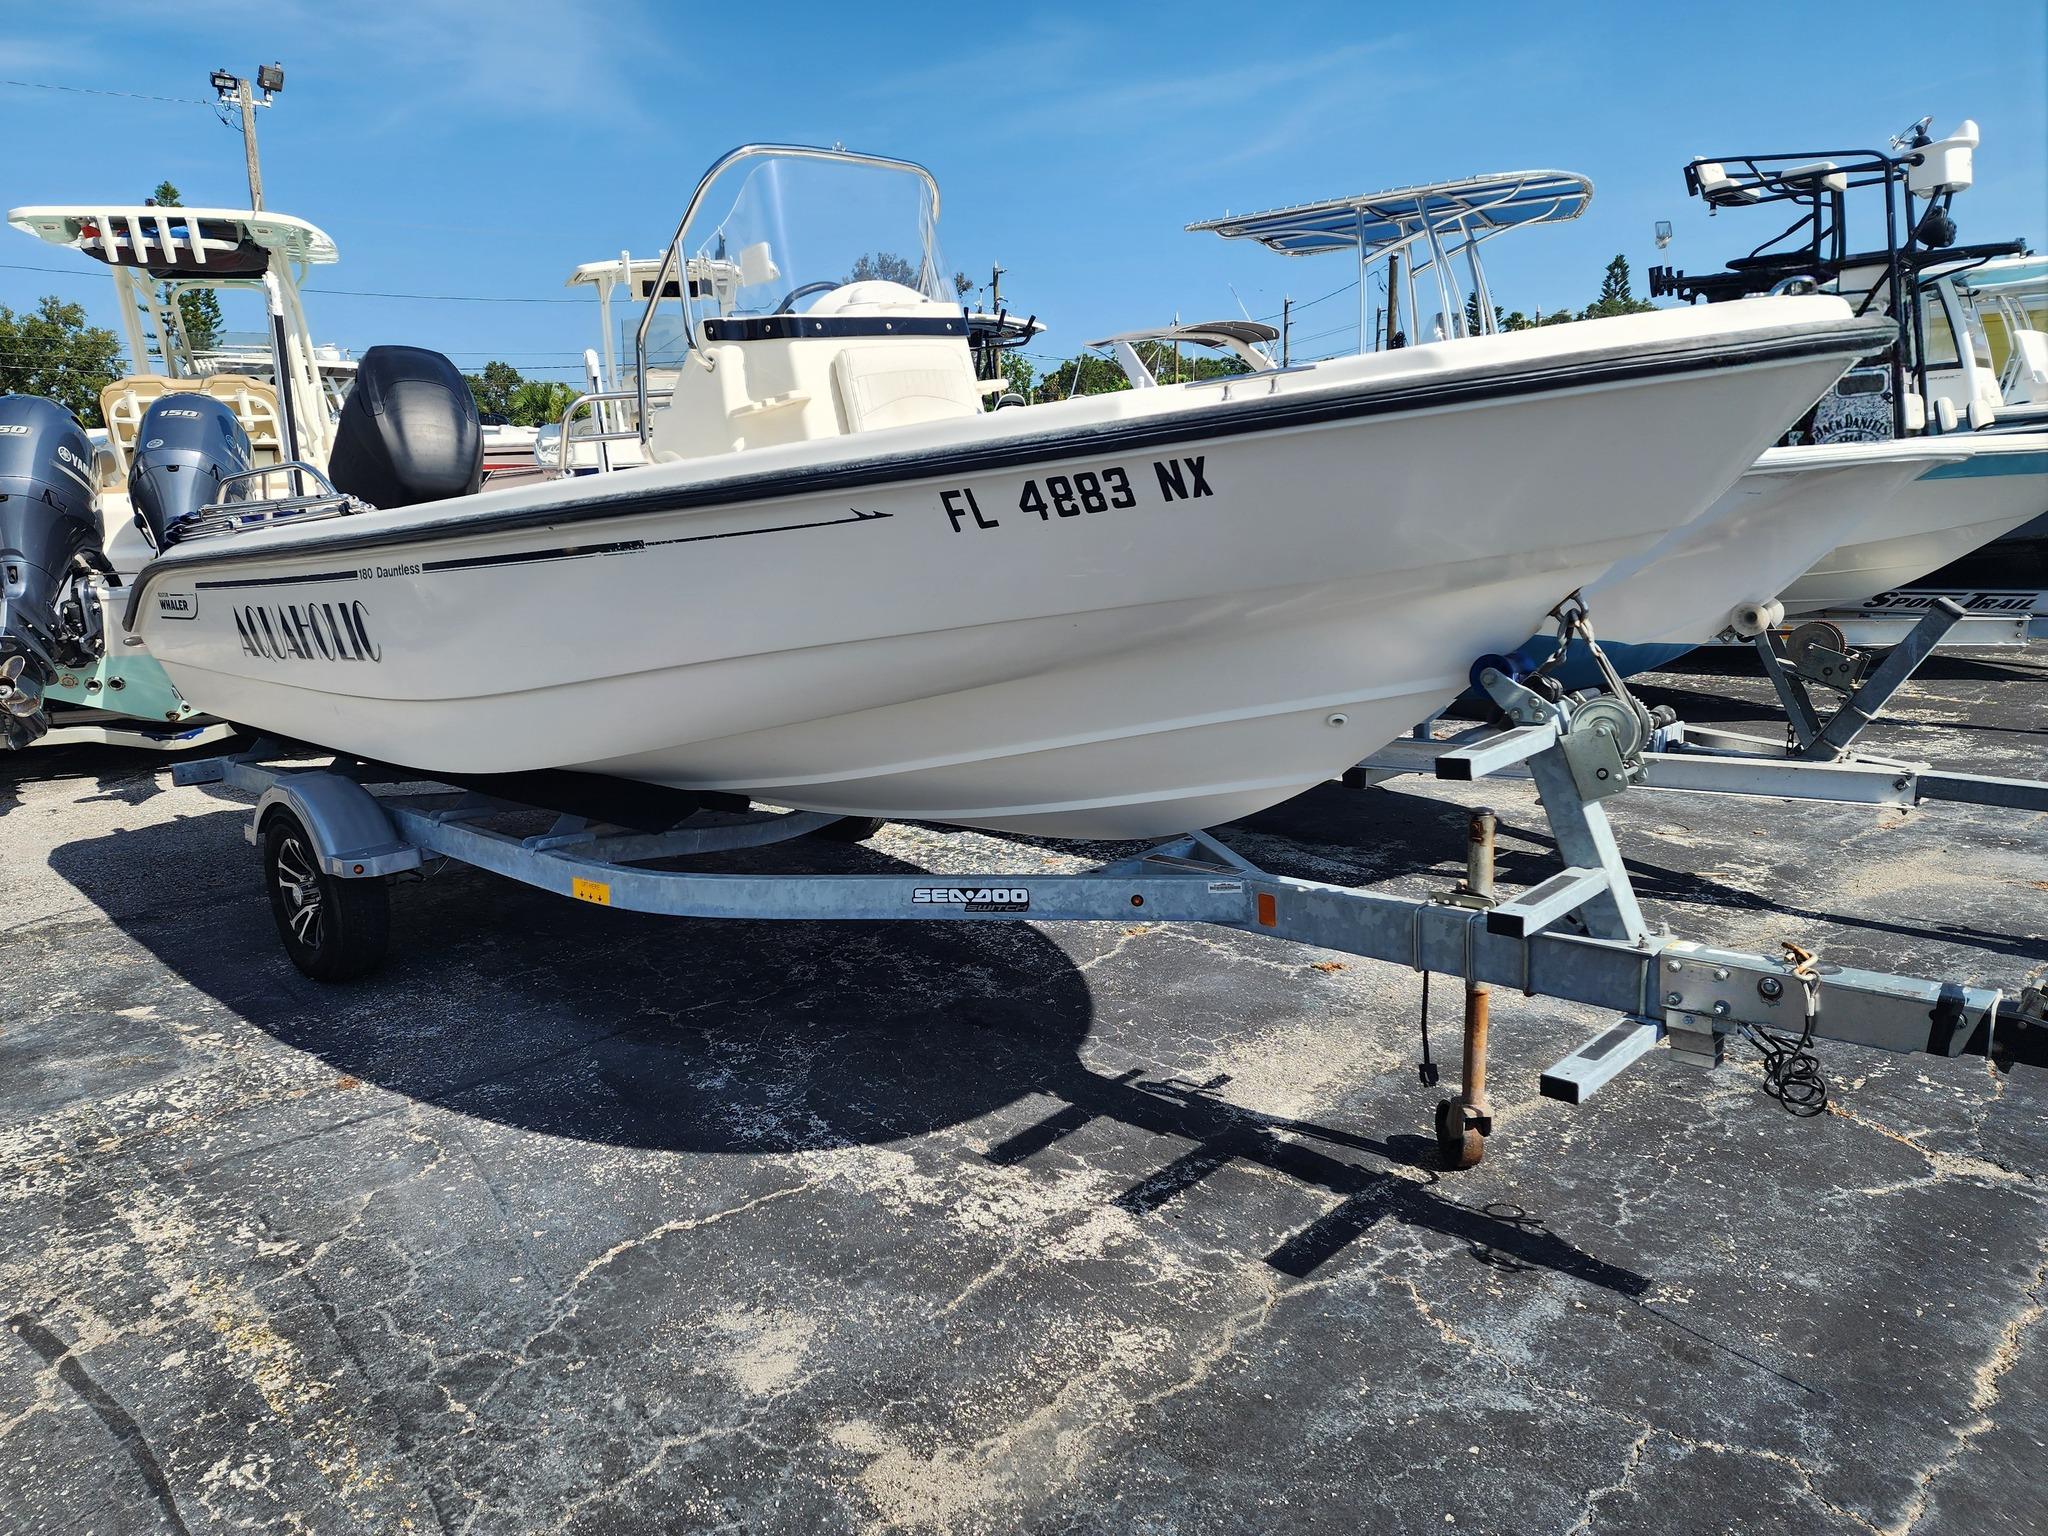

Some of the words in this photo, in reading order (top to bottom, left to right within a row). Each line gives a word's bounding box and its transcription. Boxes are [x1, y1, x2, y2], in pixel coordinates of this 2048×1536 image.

[0, 425, 28, 434] 50
[1814, 419, 1843, 440] JACK
[940, 488, 999, 533] FL
[1019, 466, 1137, 521] 4883
[1153, 456, 1214, 502] NX
[359, 568, 373, 580] 180
[376, 564, 420, 578] Dauntless
[159, 599, 189, 611] WHALER
[1862, 591, 1968, 608] SPO
[1961, 592, 2039, 610] TRAIL
[233, 599, 382, 664] AQUAHOLIC
[965, 904, 1029, 912] SWITCH
